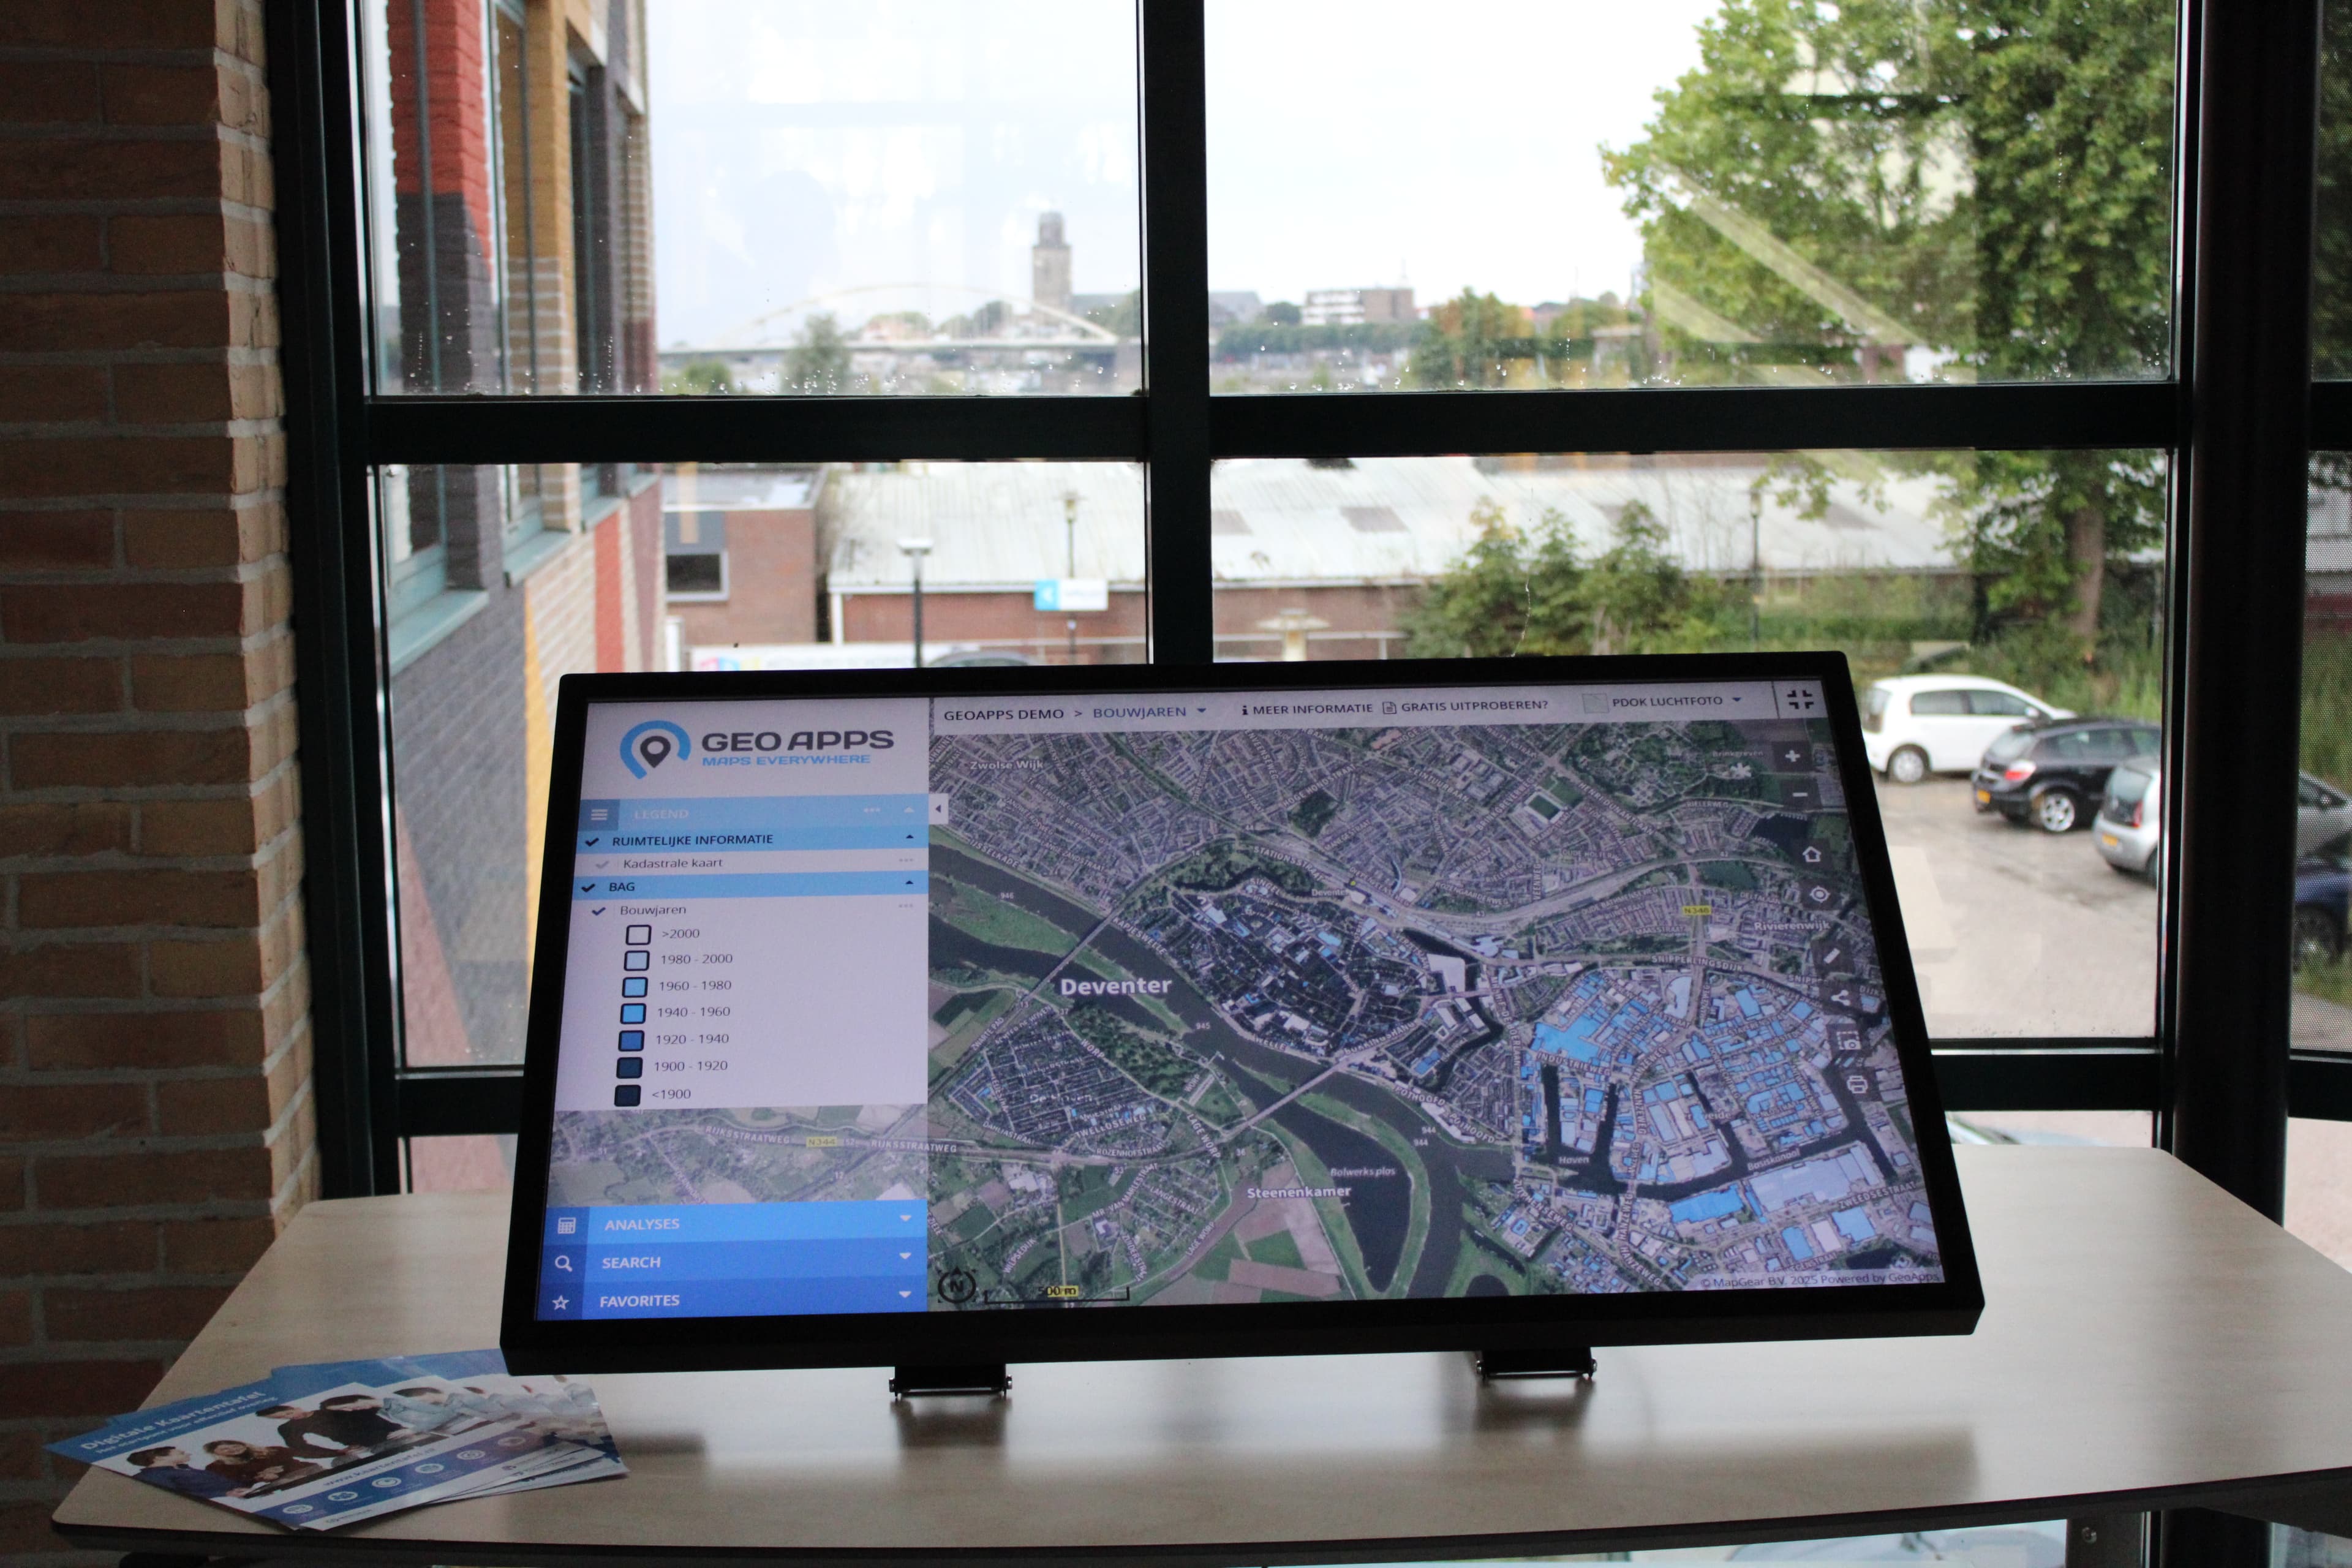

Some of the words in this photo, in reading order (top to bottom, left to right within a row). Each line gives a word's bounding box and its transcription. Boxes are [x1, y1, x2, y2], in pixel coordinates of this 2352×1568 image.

[1401, 702, 1447, 712] GRATIS
[1450, 699, 1549, 712] UITPROBEREN?
[1613, 697, 1646, 708] PDOK
[1650, 696, 1723, 707] LUCHTFOTO
[944, 709, 1014, 722] GEOAPPS
[1018, 708, 1065, 720] DEMO
[1093, 706, 1186, 720] BOUWJAREN
[1253, 705, 1289, 715] MEER
[1292, 703, 1373, 715] INFORMATIE
[701, 732, 782, 752] GEO
[787, 730, 895, 750] APPS
[702, 756, 751, 766] MAPS
[756, 754, 872, 765] EVERYWHERE
[970, 761, 1013, 771] Zwolse
[1016, 760, 1044, 771] Wijk
[634, 809, 689, 820] LEGEND
[612, 835, 692, 847] RUIMTELIJKE
[695, 834, 774, 846] INFORMATIE
[624, 858, 688, 869] Kadastrale
[692, 858, 723, 868] kaart
[609, 882, 636, 892] BAG
[620, 905, 687, 918] Bouwjaren
[1754, 919, 1831, 931] Rivierenwijk
[662, 929, 700, 938] >2000
[660, 954, 691, 965] 1980
[702, 954, 733, 963] 2000
[658, 981, 690, 992] 1960
[699, 980, 732, 990] 1980
[1060, 978, 1172, 996] Deventer
[657, 1008, 688, 1017] 1940
[699, 1006, 731, 1017] 1960
[655, 1034, 687, 1045] 1920
[698, 1033, 729, 1044] 1940
[654, 1061, 685, 1072] 1900
[697, 1060, 728, 1071] 1920
[652, 1089, 692, 1100] <1900
[1186, 1112, 1204, 1136] LAGE
[1201, 1134, 1221, 1159] WORP
[808, 1137, 837, 1147] N344
[871, 1139, 957, 1153] RIJKSSTRAATWEG
[1558, 1155, 1590, 1164] Haven
[1374, 1166, 1396, 1177] plas
[1246, 1186, 1352, 1199] Steenenkamer
[605, 1218, 680, 1231] ANALYSES
[602, 1256, 662, 1269] SEARCH
[1713, 1276, 1765, 1290] MapGear
[1790, 1275, 1819, 1285] 2025
[1820, 1273, 1869, 1284] Powered
[1872, 1272, 1886, 1284] by
[1888, 1272, 1940, 1283] GeoApps
[600, 1294, 680, 1308] FAVORITES
